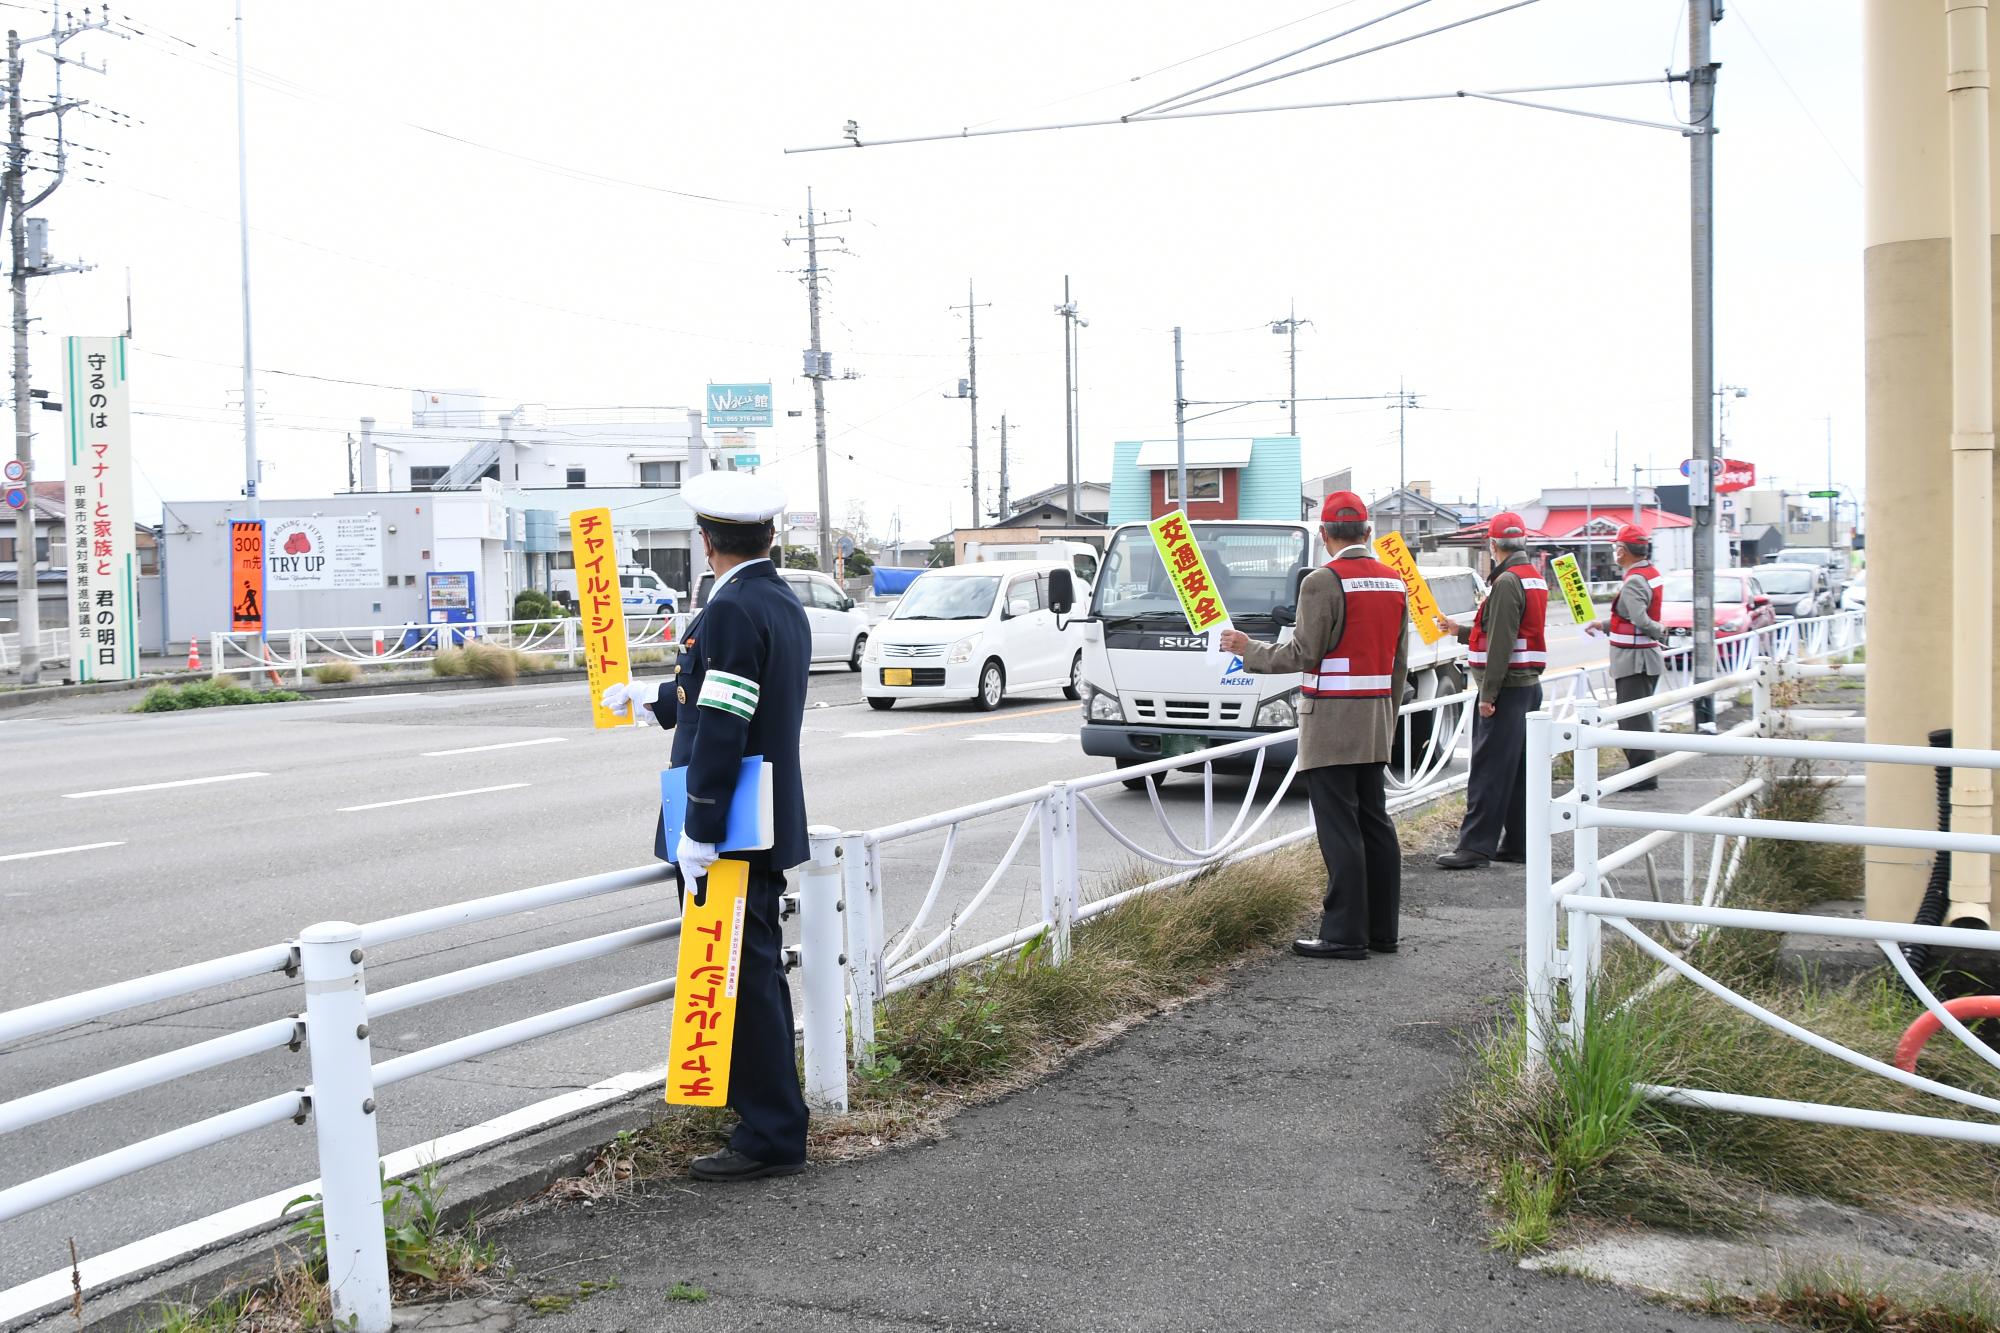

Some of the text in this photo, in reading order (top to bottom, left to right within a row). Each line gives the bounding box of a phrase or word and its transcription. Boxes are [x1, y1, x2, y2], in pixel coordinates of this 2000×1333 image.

[87, 352, 115, 666] 守るのは マナーと家族と 君の明日
[234, 537, 260, 552] 300
[74, 485, 91, 639] 甲斐市交通対策推進協議会
[242, 554, 262, 570] m先
[269, 556, 325, 572] TRY UP
[579, 515, 618, 674] チャイルドシート
[1159, 516, 1222, 627] 交通安全
[1380, 537, 1430, 616] チャイルドシート
[1220, 677, 1254, 686] AMESEKI
[679, 920, 725, 1097] チャイルドシート
